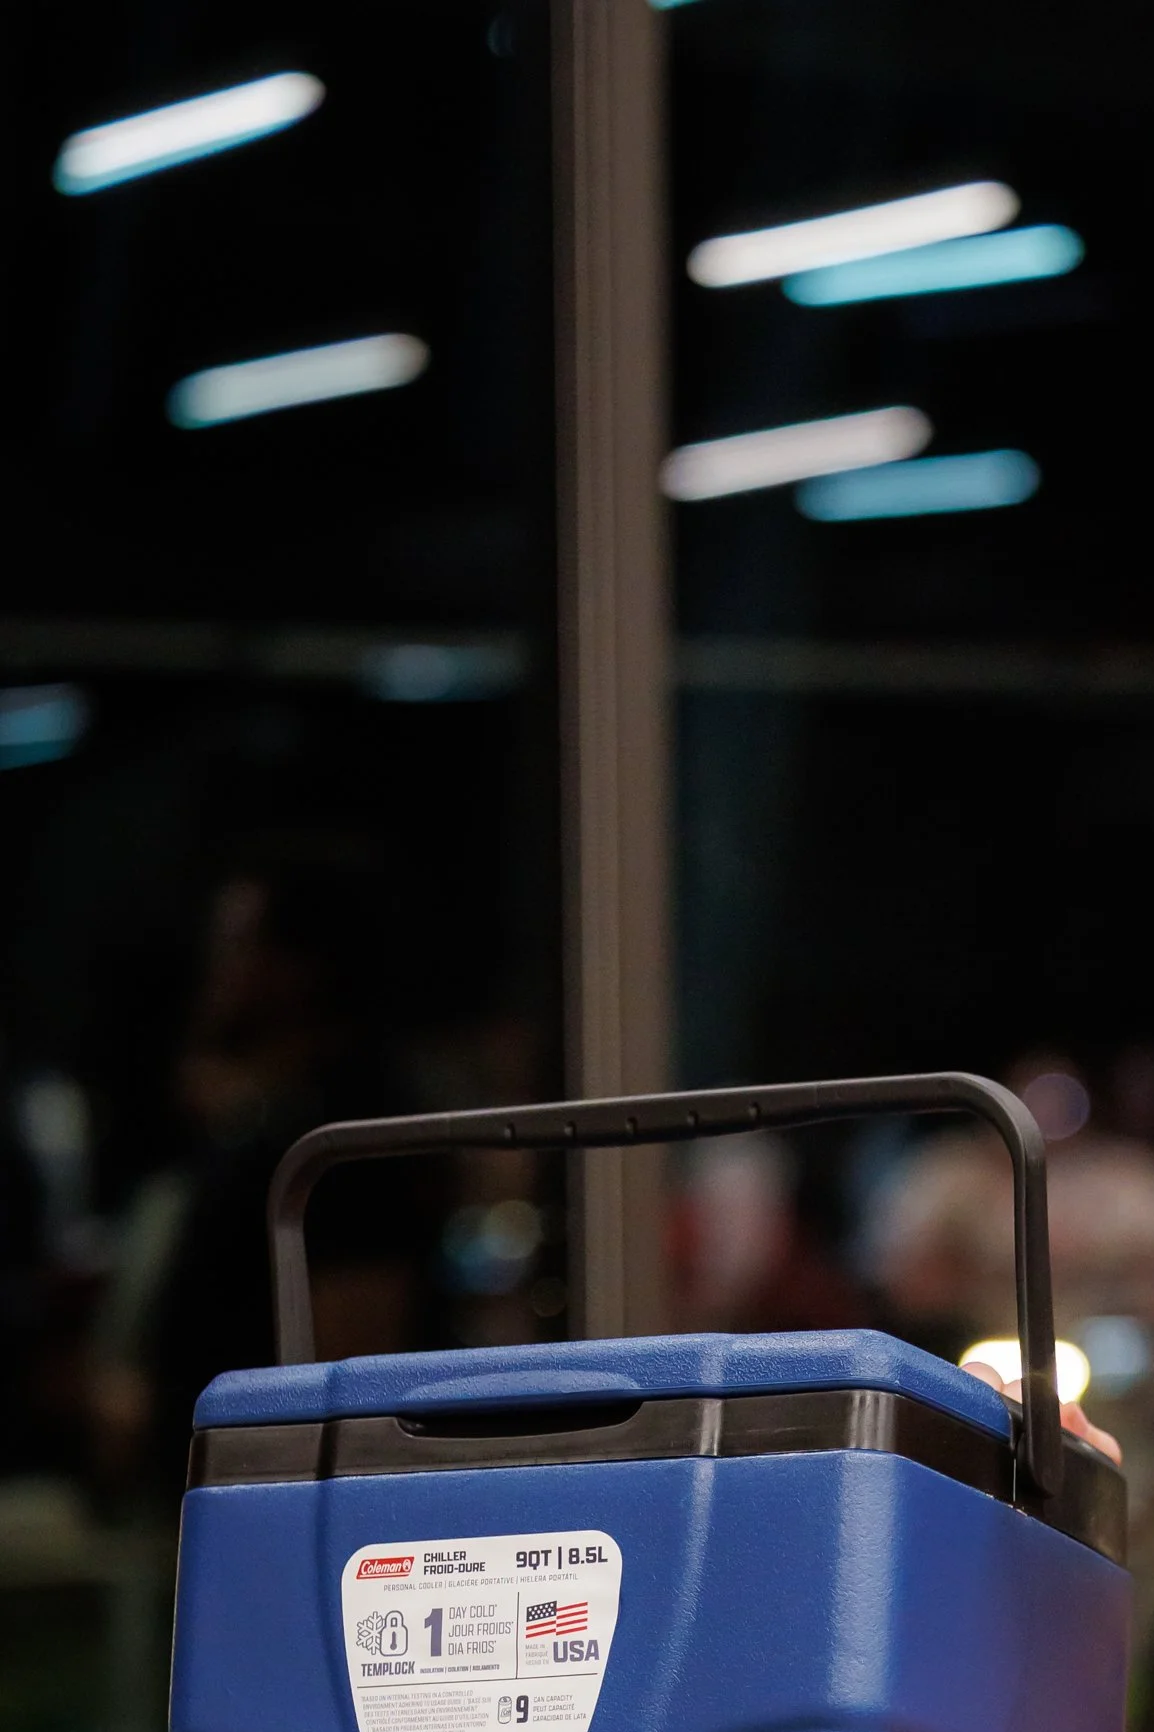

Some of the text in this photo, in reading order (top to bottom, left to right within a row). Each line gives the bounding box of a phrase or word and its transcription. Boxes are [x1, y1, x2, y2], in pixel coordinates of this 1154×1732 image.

[424, 1551, 466, 1563] CHILLER
[516, 1545, 608, 1570] 9QT 8.5L
[361, 1559, 402, 1576] Coleman
[424, 1562, 486, 1575] FROID-DURE
[480, 1577, 514, 1585] PORTATIVE
[520, 1575, 547, 1583] HIELERA
[383, 1581, 443, 1592] PERSONAL COOLER
[449, 1607, 468, 1620] DAY
[424, 1608, 443, 1657] 1
[449, 1624, 474, 1637] JOUR
[553, 1639, 600, 1663] USA
[361, 1661, 415, 1677] TEMPLOCK
[516, 1695, 529, 1723] 9
[532, 1714, 564, 1722] CAPACIDAD
